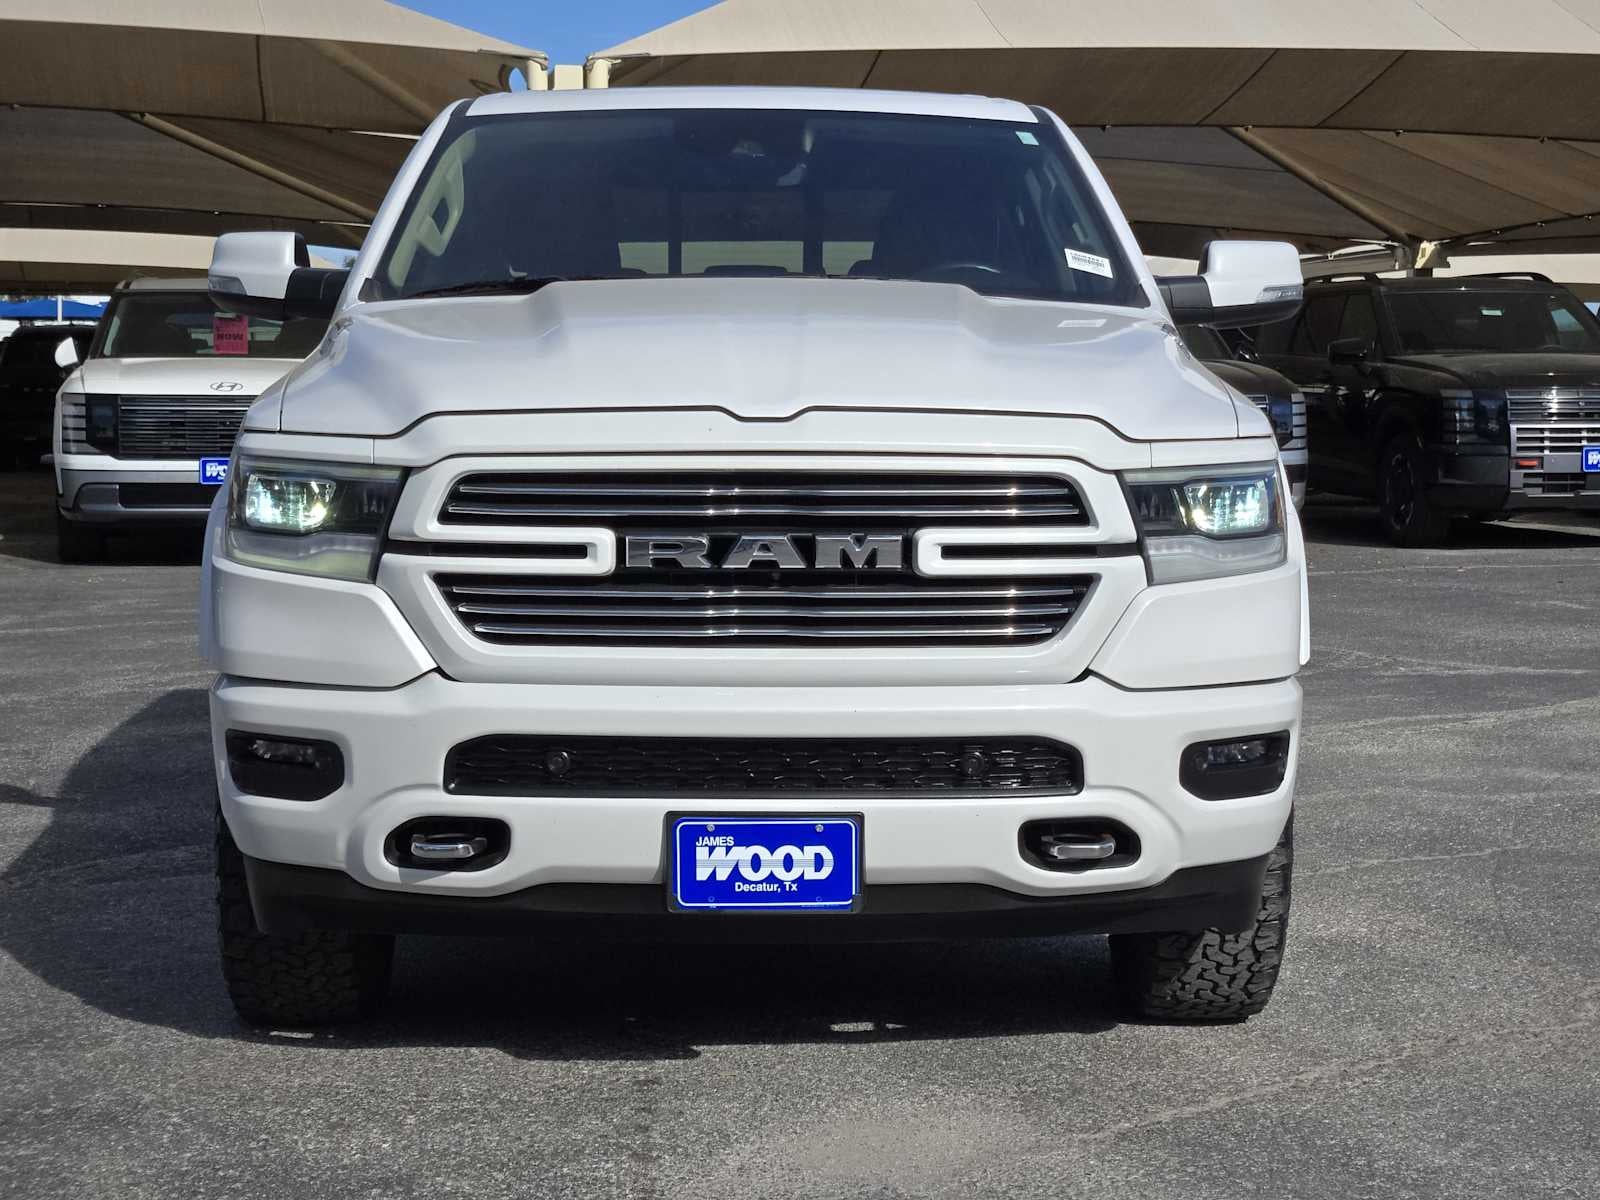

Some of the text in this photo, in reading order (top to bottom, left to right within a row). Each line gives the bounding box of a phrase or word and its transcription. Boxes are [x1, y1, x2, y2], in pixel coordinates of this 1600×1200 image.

[625, 534, 903, 568] RAM
[696, 836, 735, 846] JAMES
[695, 845, 834, 881] WOOD
[735, 882, 798, 893] Decatur, Tx
